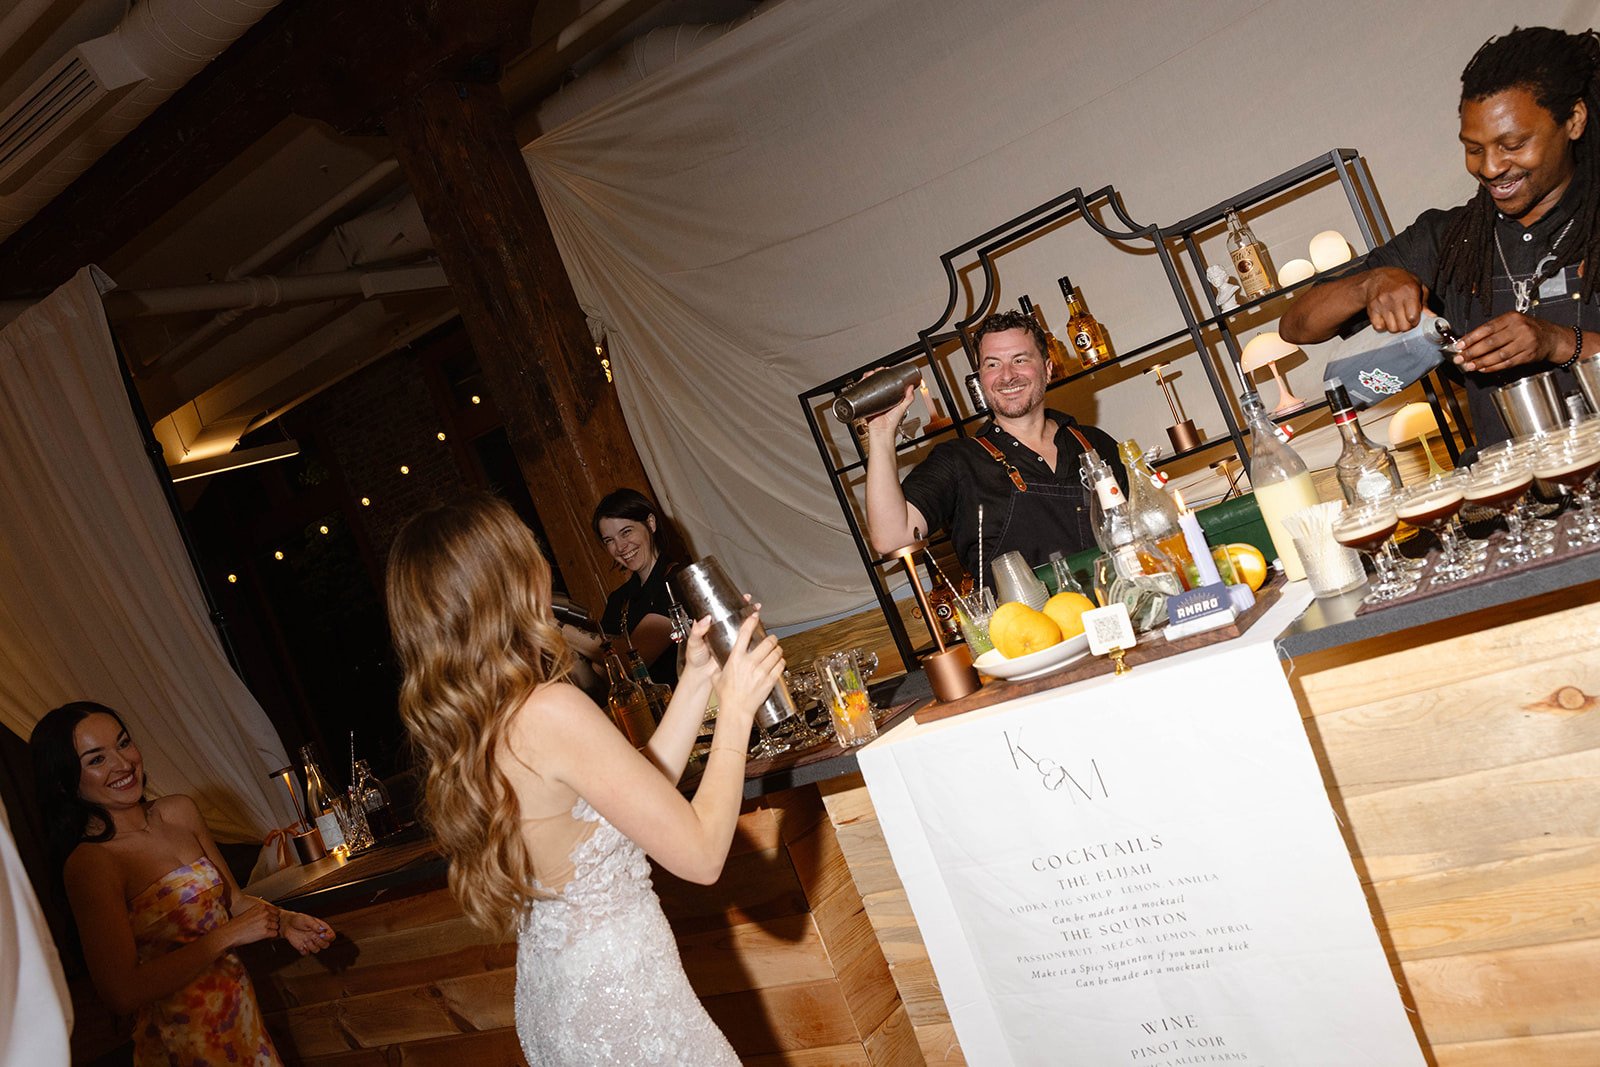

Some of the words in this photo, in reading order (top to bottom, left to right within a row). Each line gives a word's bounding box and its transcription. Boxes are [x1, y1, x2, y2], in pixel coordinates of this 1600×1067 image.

[1177, 598, 1219, 619] AMARO
[1031, 834, 1163, 872] COCKTAILS
[1054, 898, 1073, 907] FIG
[1168, 873, 1219, 886] VANILLA
[1057, 874, 1090, 890] THE
[1096, 863, 1152, 882] ELIJAH
[1052, 915, 1071, 925] Can
[1074, 913, 1084, 922] be
[1088, 906, 1114, 919] made
[1142, 894, 1185, 907] mocktail
[1061, 928, 1093, 941] THE
[1099, 911, 1188, 936] SQUINTON
[1206, 923, 1253, 936] APEROL
[1031, 969, 1057, 980] Make
[1079, 963, 1104, 975] Spicy
[1108, 953, 1153, 970] Squinton
[1157, 949, 1165, 962] if
[1169, 950, 1185, 961] you
[1189, 945, 1214, 955] want
[1228, 941, 1249, 952] kick
[1075, 978, 1095, 988] Can
[1098, 976, 1108, 985] be
[1112, 970, 1139, 982] made
[1143, 968, 1153, 976] as
[1166, 959, 1209, 972] mocktail
[1141, 1014, 1198, 1035] WINE
[1130, 1039, 1179, 1059] PINOT
[1186, 1036, 1226, 1048] NOIR
[1166, 1054, 1209, 1067] VALLEY
[1210, 1052, 1248, 1062] FARMS
